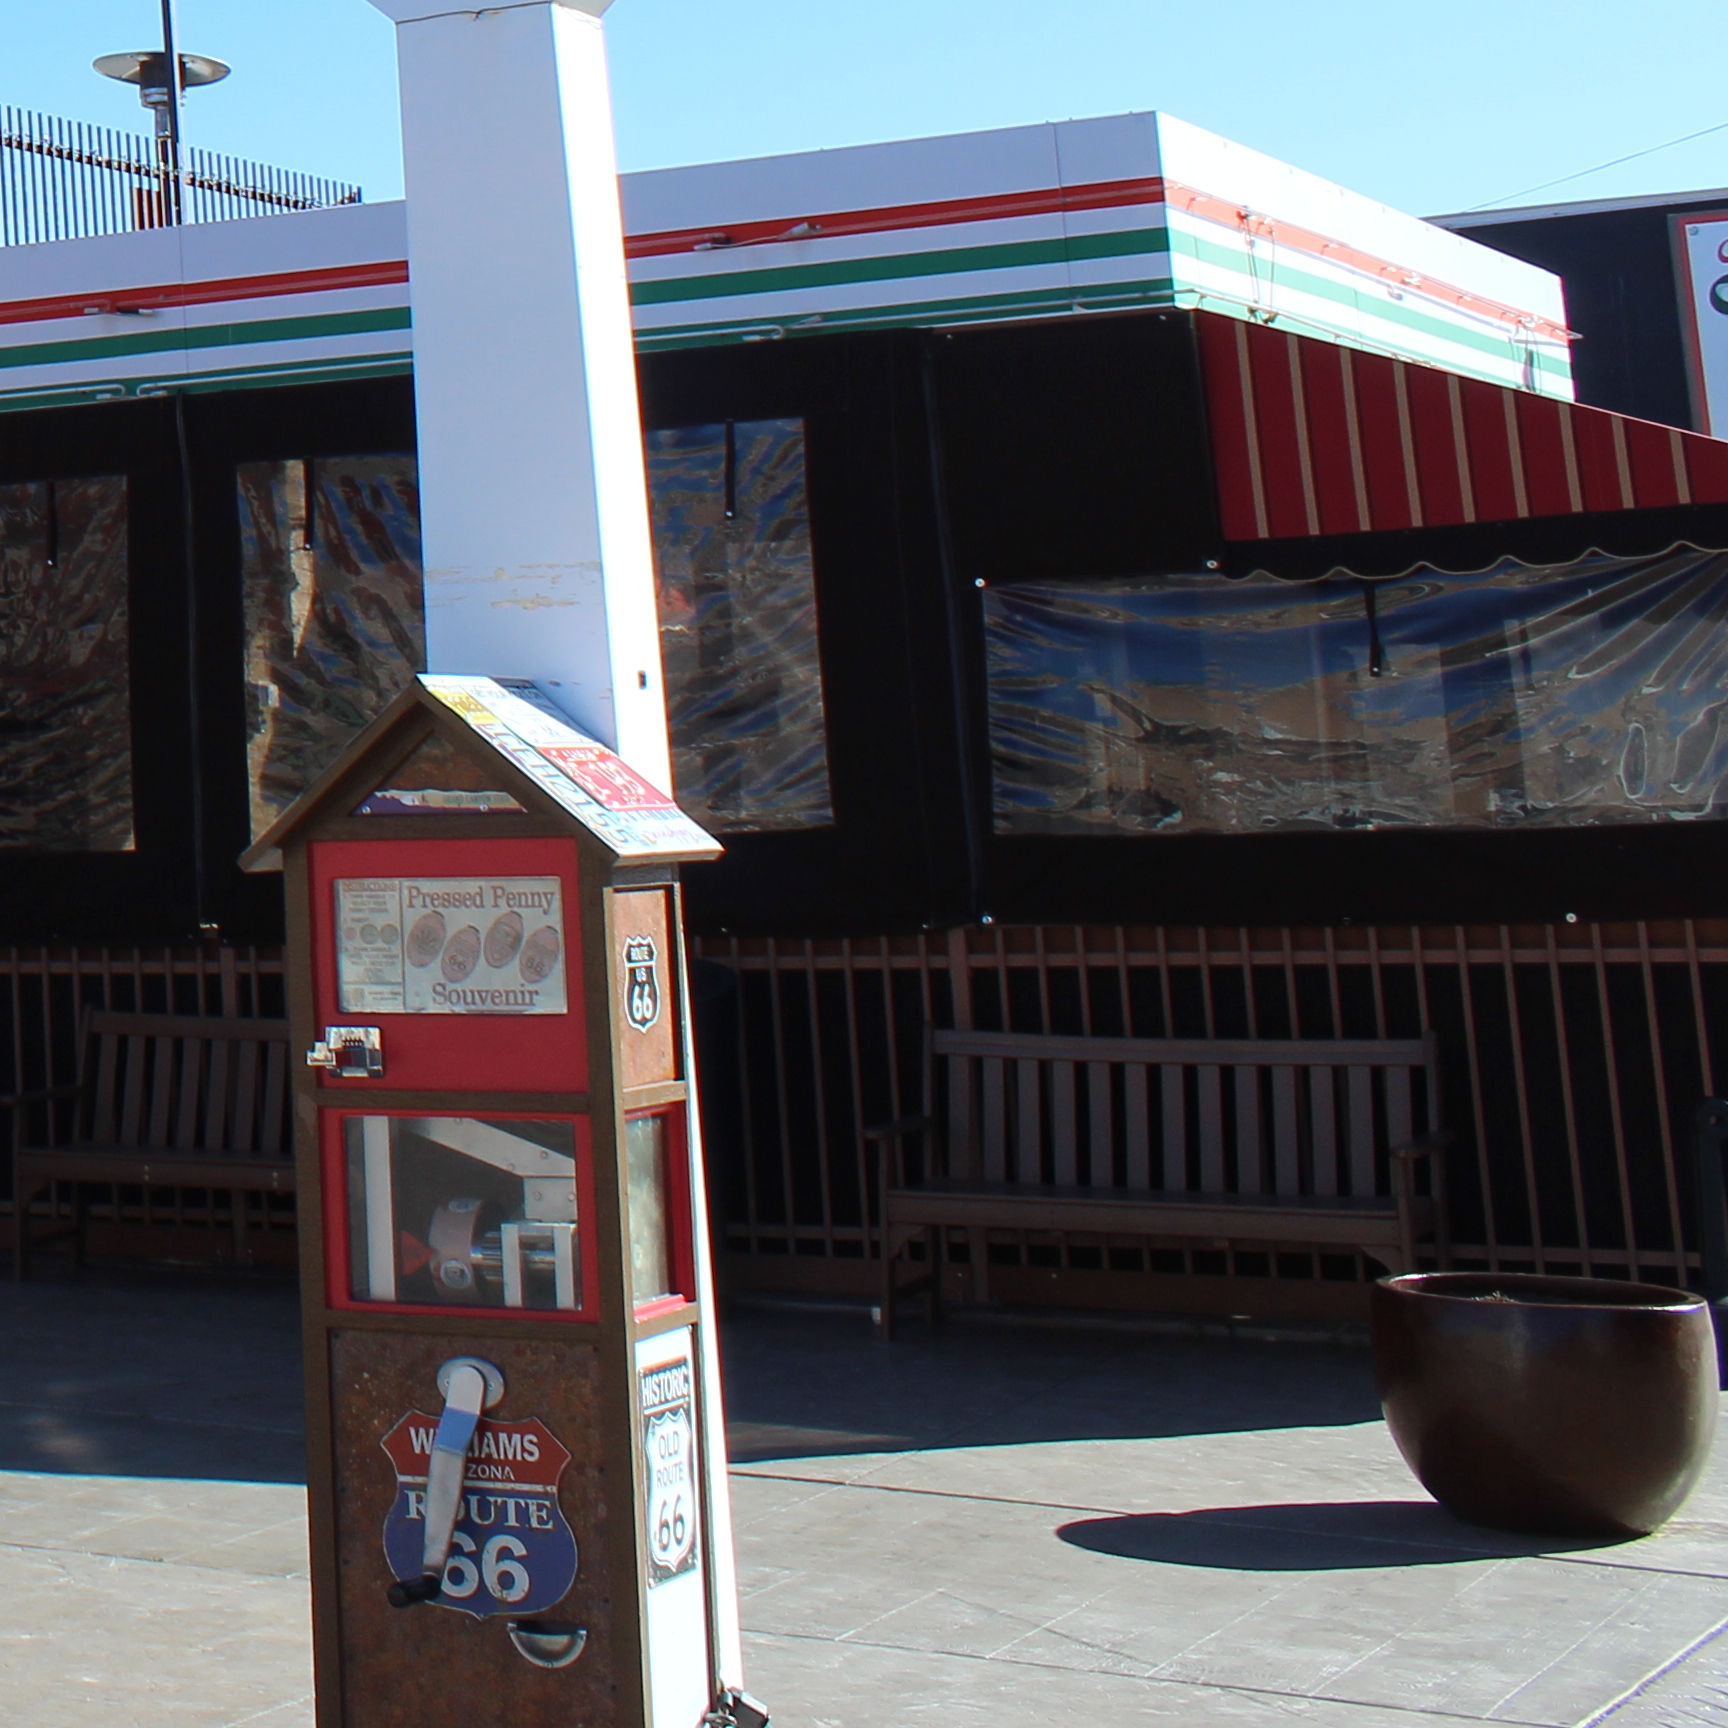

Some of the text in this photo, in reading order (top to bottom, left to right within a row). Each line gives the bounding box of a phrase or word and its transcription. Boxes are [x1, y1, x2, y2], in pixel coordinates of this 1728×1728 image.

[406, 885, 485, 909] Pressed
[491, 885, 555, 915] Penny
[432, 983, 539, 1007] Souvenir
[632, 983, 653, 1021] 66
[641, 1365, 689, 1406] HISTORIC
[409, 1426, 540, 1462] WIAMS
[658, 1430, 680, 1460] OLD
[656, 1460, 684, 1489] ROUTE
[404, 1490, 554, 1529] RUTE
[659, 1493, 685, 1552] 66
[440, 1531, 530, 1603] 66
